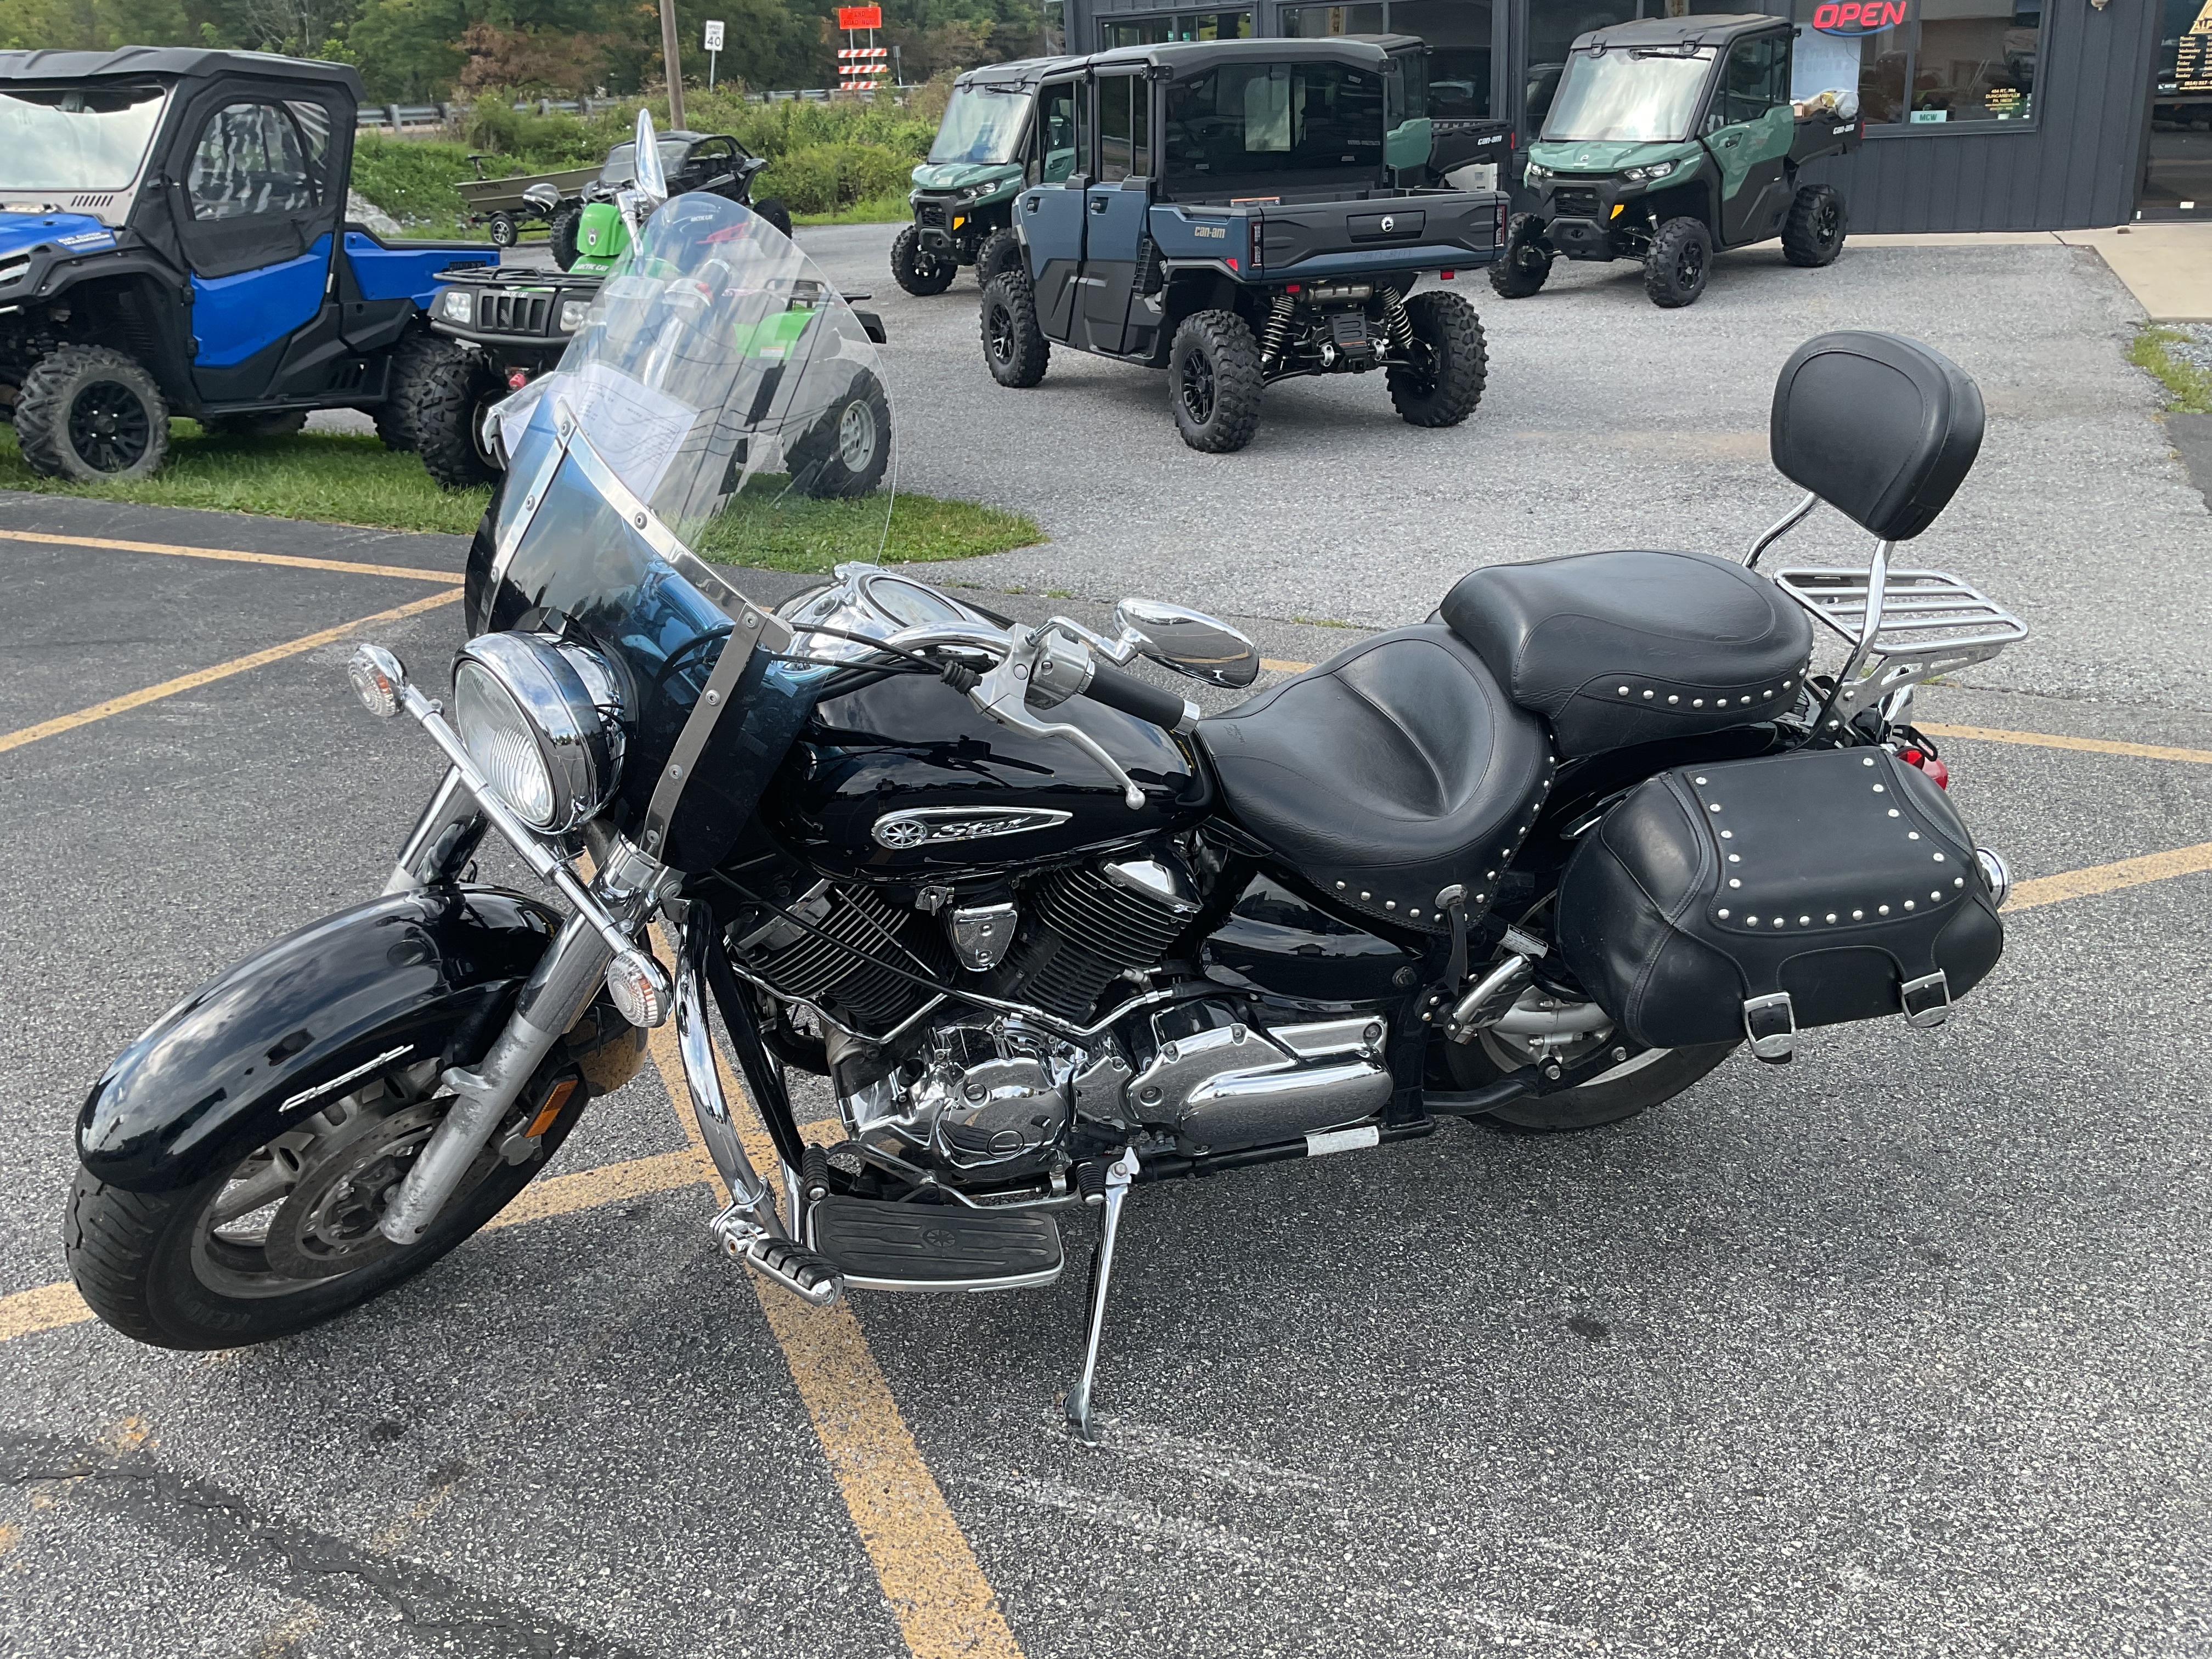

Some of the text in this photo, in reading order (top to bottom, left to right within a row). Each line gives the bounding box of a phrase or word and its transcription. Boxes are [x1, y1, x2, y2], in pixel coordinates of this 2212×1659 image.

[1813, 1, 1906, 29] OPEN
[707, 36, 721, 47] 40
[1920, 113, 1937, 121] MCW
[1832, 123, 1855, 135] can-am
[1477, 135, 1503, 145] can-am
[1194, 226, 1226, 239] can-am
[932, 816, 1031, 838] Star
